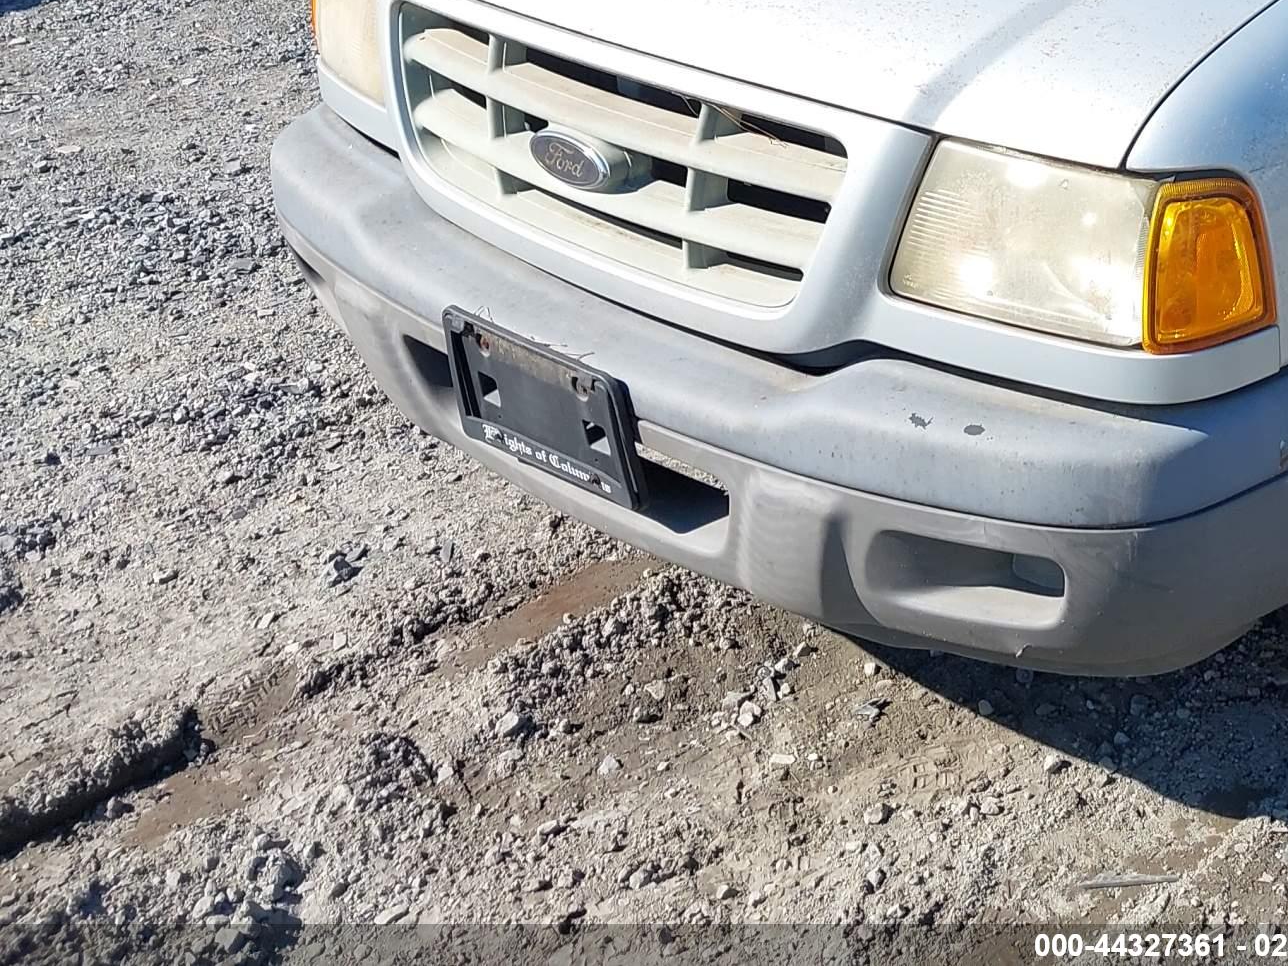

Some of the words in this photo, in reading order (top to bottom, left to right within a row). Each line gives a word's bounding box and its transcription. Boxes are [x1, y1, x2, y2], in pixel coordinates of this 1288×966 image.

[544, 142, 585, 177] Ford
[535, 450, 547, 463] of
[548, 453, 612, 494] Columus
